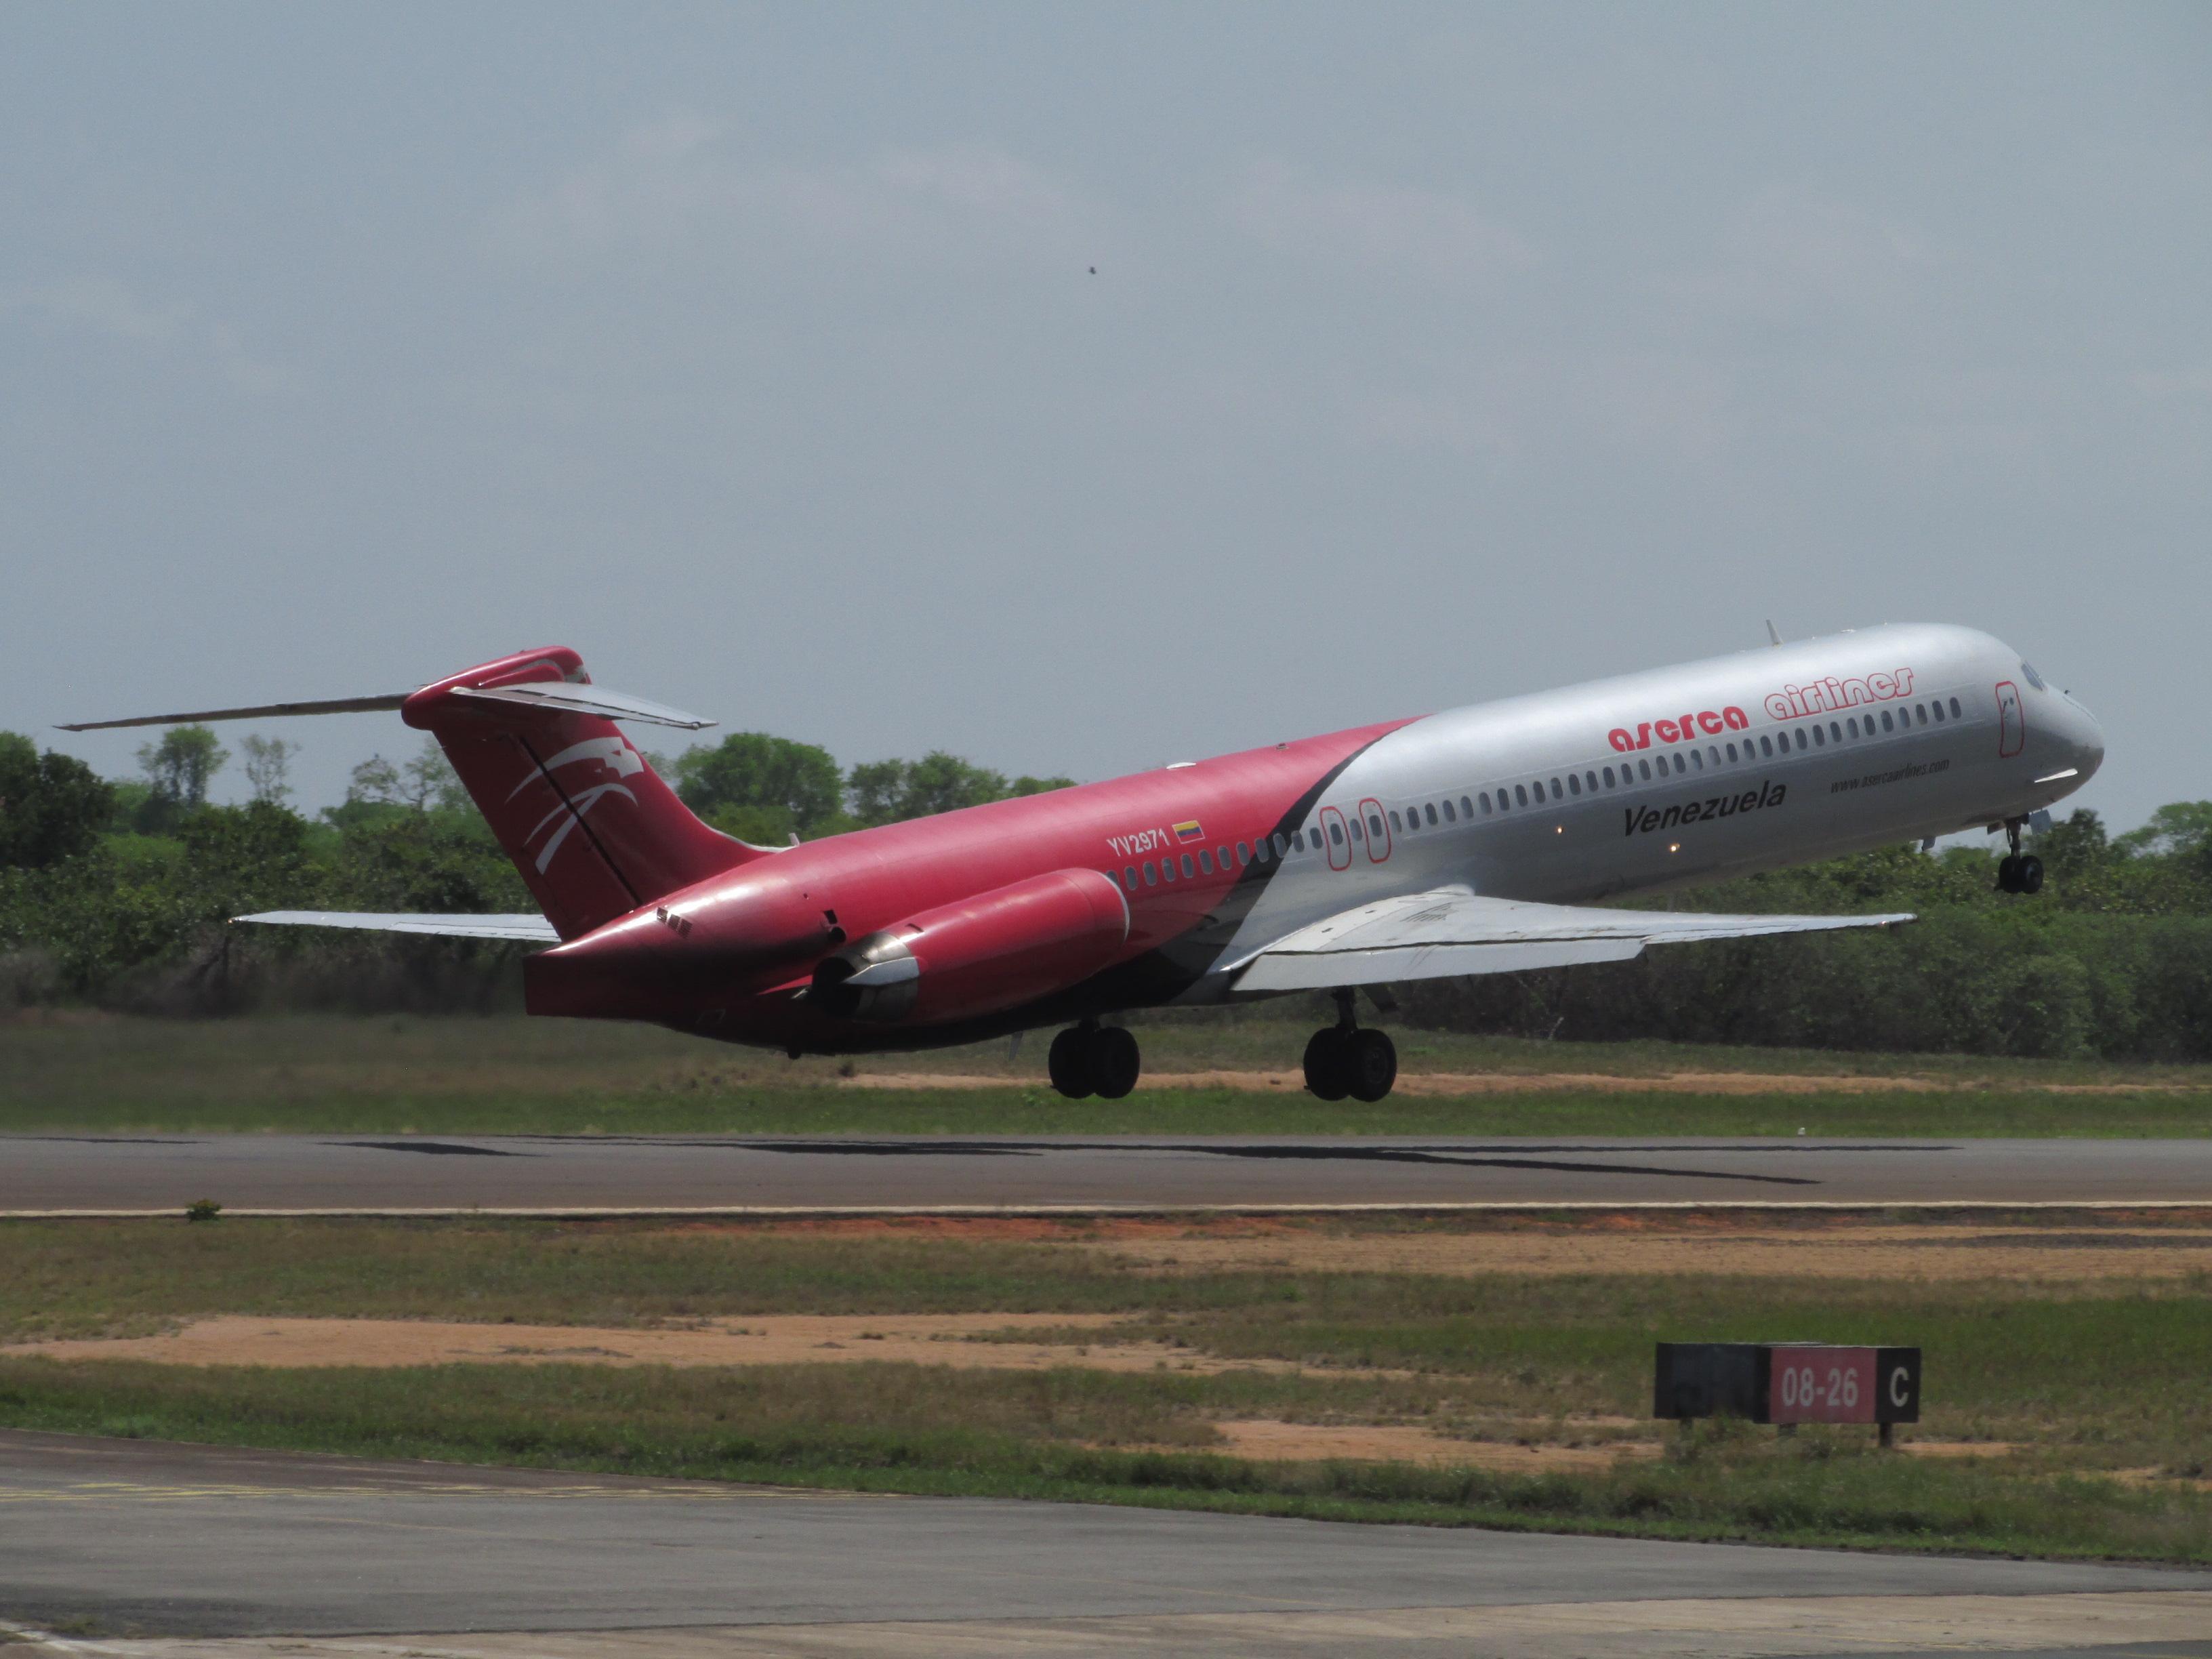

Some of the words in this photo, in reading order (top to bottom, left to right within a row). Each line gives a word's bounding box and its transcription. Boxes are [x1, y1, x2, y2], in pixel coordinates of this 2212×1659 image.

[1608, 706, 1749, 752] aserca
[1765, 668, 1913, 720] airlines
[1831, 759, 1950, 794] www.asercaairlines.com
[1624, 780, 1786, 836] Venezuela
[1106, 828, 1170, 857] YV2971
[1782, 1368, 1858, 1407] 08-26
[1889, 1367, 1910, 1407] C
